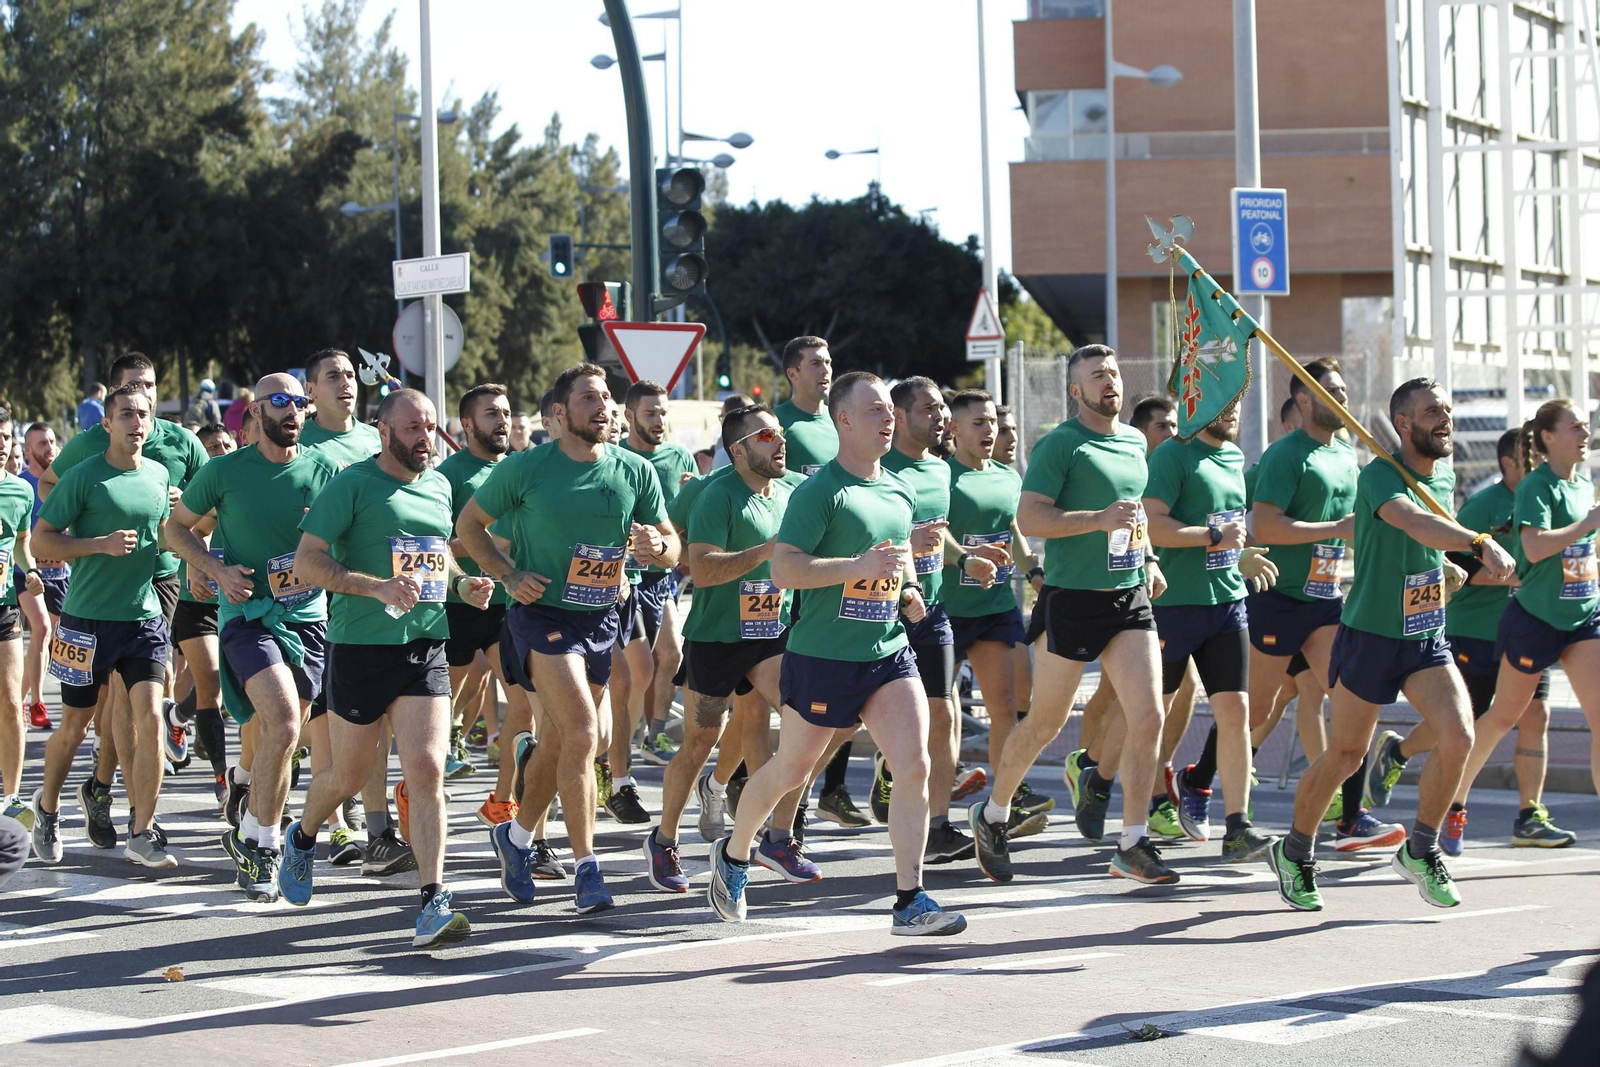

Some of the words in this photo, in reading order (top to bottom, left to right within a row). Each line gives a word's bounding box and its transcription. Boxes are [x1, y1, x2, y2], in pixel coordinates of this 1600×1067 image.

[1240, 197, 1282, 208] PRIORIDAD
[1241, 209, 1281, 220] PEATONAL
[420, 263, 439, 272] CALLE
[1257, 268, 1268, 277] 10
[400, 553, 445, 572] 2459
[576, 560, 619, 579] 2449
[1410, 584, 1443, 606] 243
[54, 638, 88, 663] 2765
